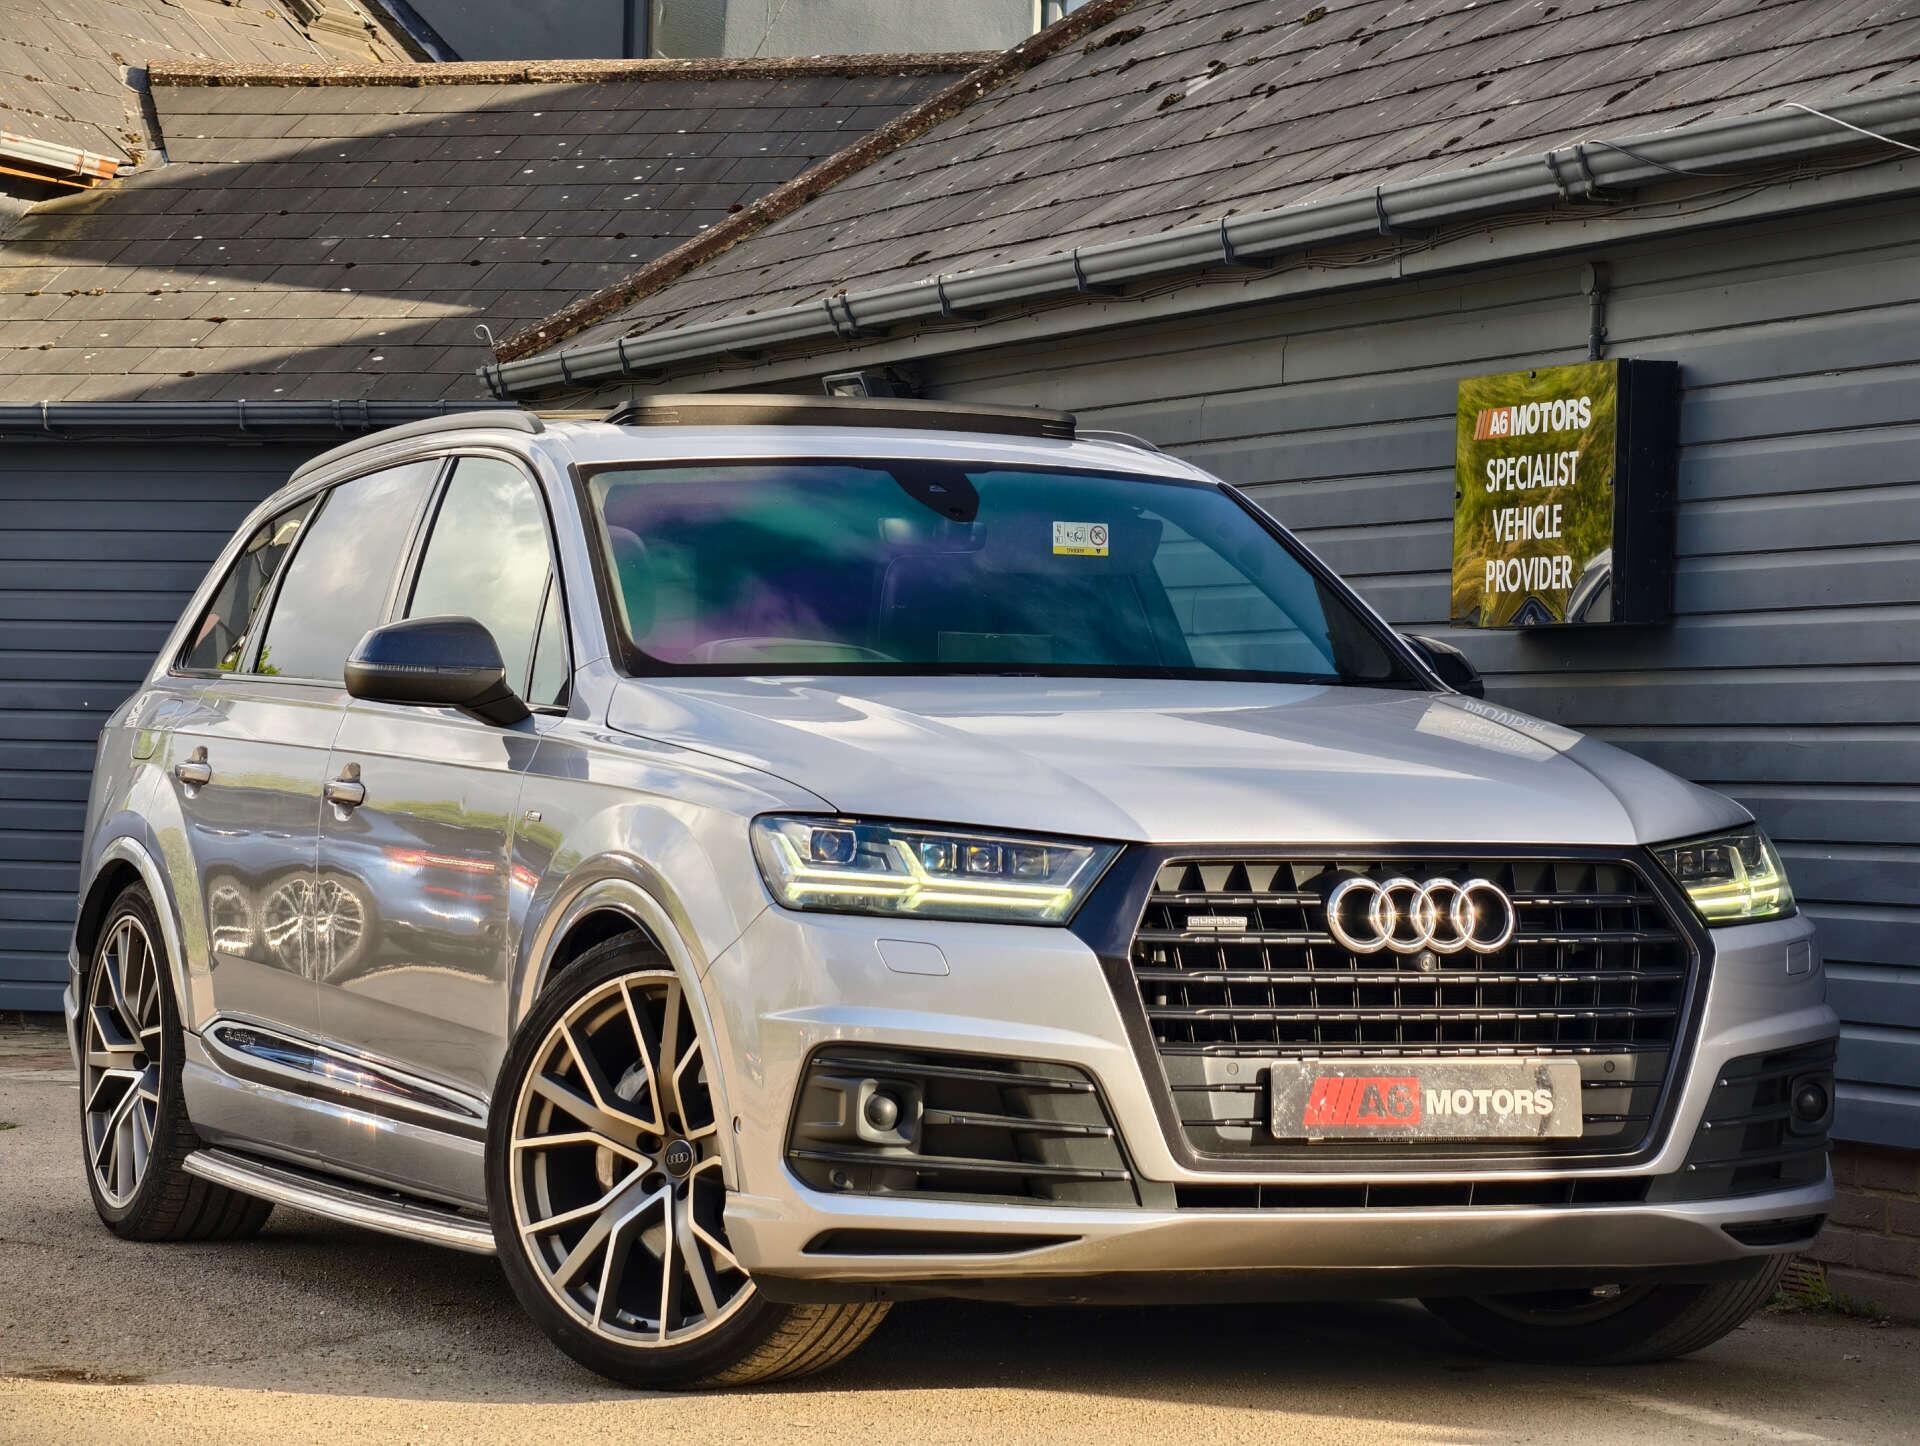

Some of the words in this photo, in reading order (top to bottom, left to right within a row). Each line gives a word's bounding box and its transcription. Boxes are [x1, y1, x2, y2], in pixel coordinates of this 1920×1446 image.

[1489, 411, 1508, 435] A6
[1510, 396, 1591, 436] MOTORS
[1486, 451, 1579, 493] SPECIALIST
[1493, 504, 1562, 543] VEHICLE
[1485, 555, 1573, 593] PROVIDER
[1357, 1083, 1415, 1119] A6
[1426, 1089, 1554, 1115] MOTORS
